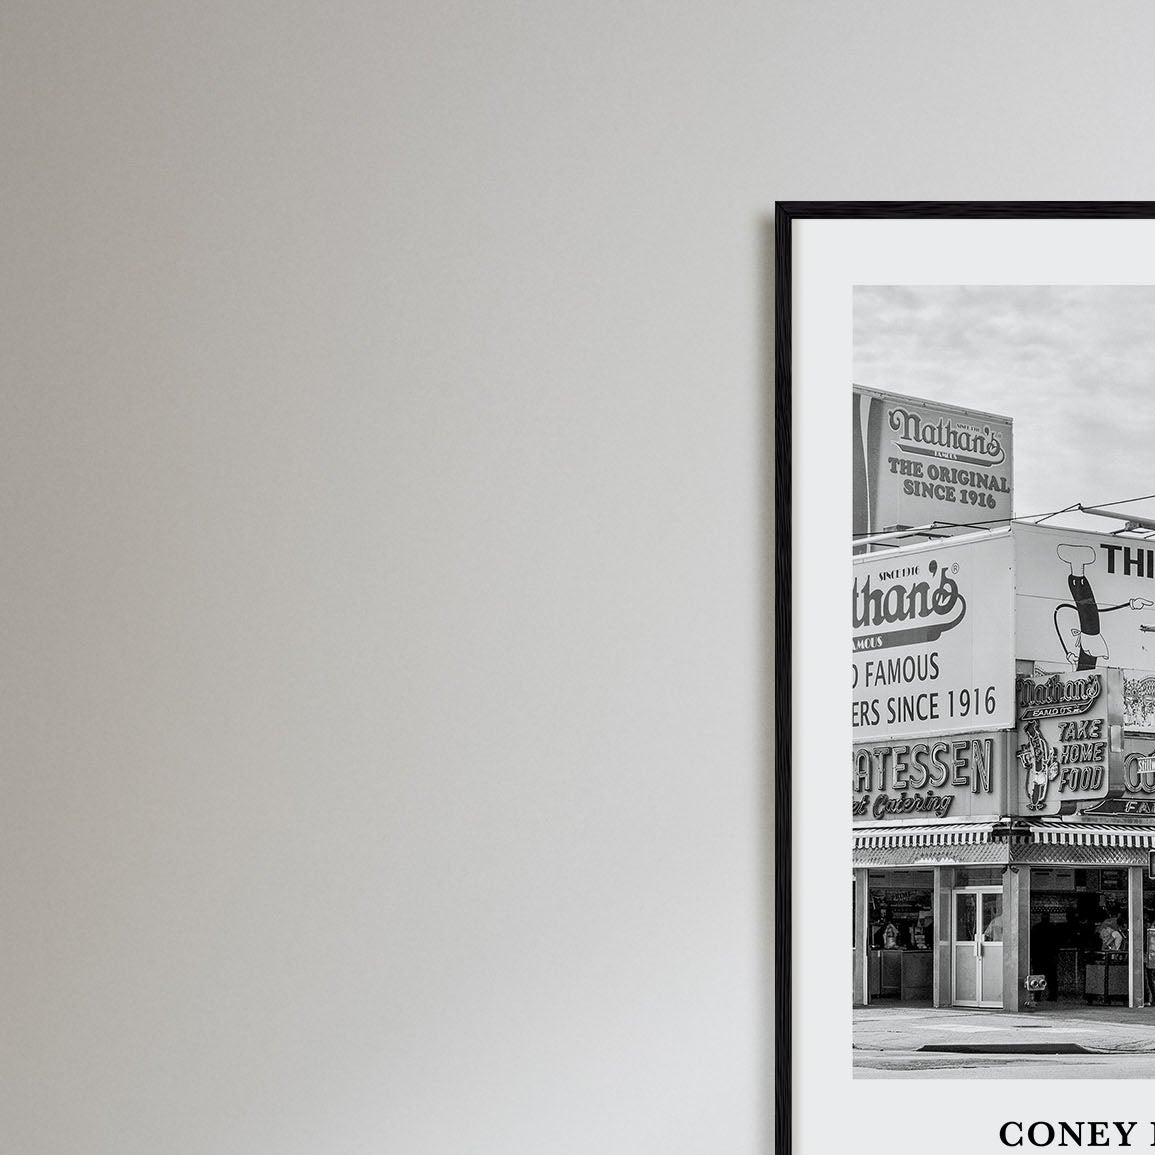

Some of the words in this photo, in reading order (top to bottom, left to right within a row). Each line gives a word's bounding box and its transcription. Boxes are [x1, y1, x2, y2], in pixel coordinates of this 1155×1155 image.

[888, 409, 1002, 457] Nathan's
[888, 457, 923, 478] THE
[927, 464, 1010, 494] ORIGINAL
[903, 479, 956, 502] SINCE
[960, 490, 997, 509] 1916
[879, 567, 901, 581] SINCE
[865, 652, 940, 688] FAMOUS
[887, 692, 940, 724] SINCE
[948, 686, 996, 718] 1916
[1032, 706, 1074, 717] FAMOUS
[1058, 718, 1105, 742] TAKE
[854, 739, 994, 793] ATESSEN
[1060, 742, 1107, 765] HOME
[1058, 765, 1105, 793] FOOD
[873, 790, 955, 820] Catering
[999, 1121, 1138, 1147] CONEY
